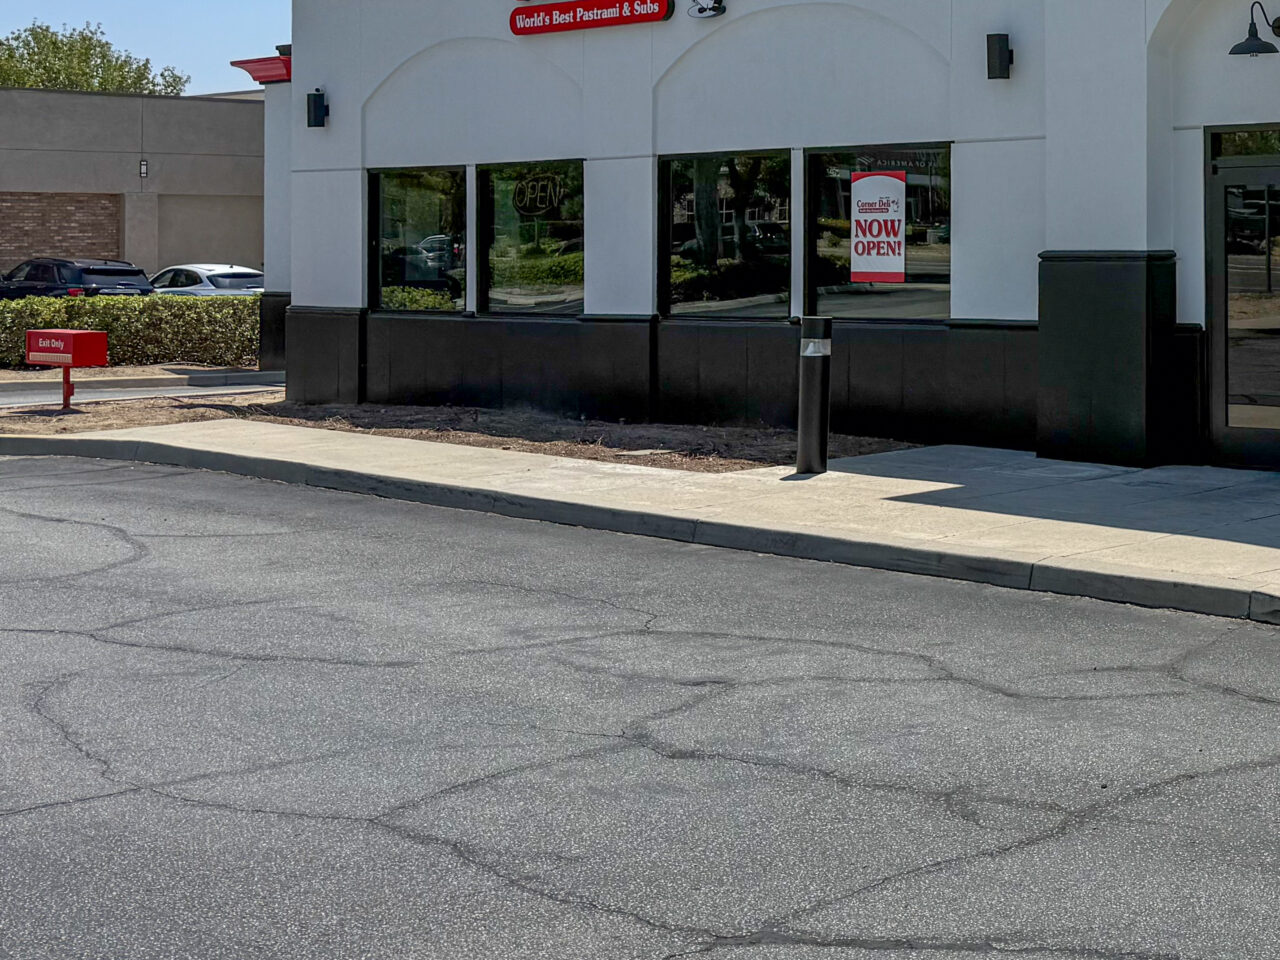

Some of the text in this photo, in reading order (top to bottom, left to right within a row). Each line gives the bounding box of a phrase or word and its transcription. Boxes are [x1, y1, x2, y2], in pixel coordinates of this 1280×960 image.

[515, 0, 659, 29] World's Best Pastrami & Subs
[515, 179, 560, 208] OPEN
[856, 199, 891, 208] Corner Deli
[854, 218, 902, 239] NOW
[853, 240, 902, 257] OPEN!
[38, 338, 65, 351] Exit Only
